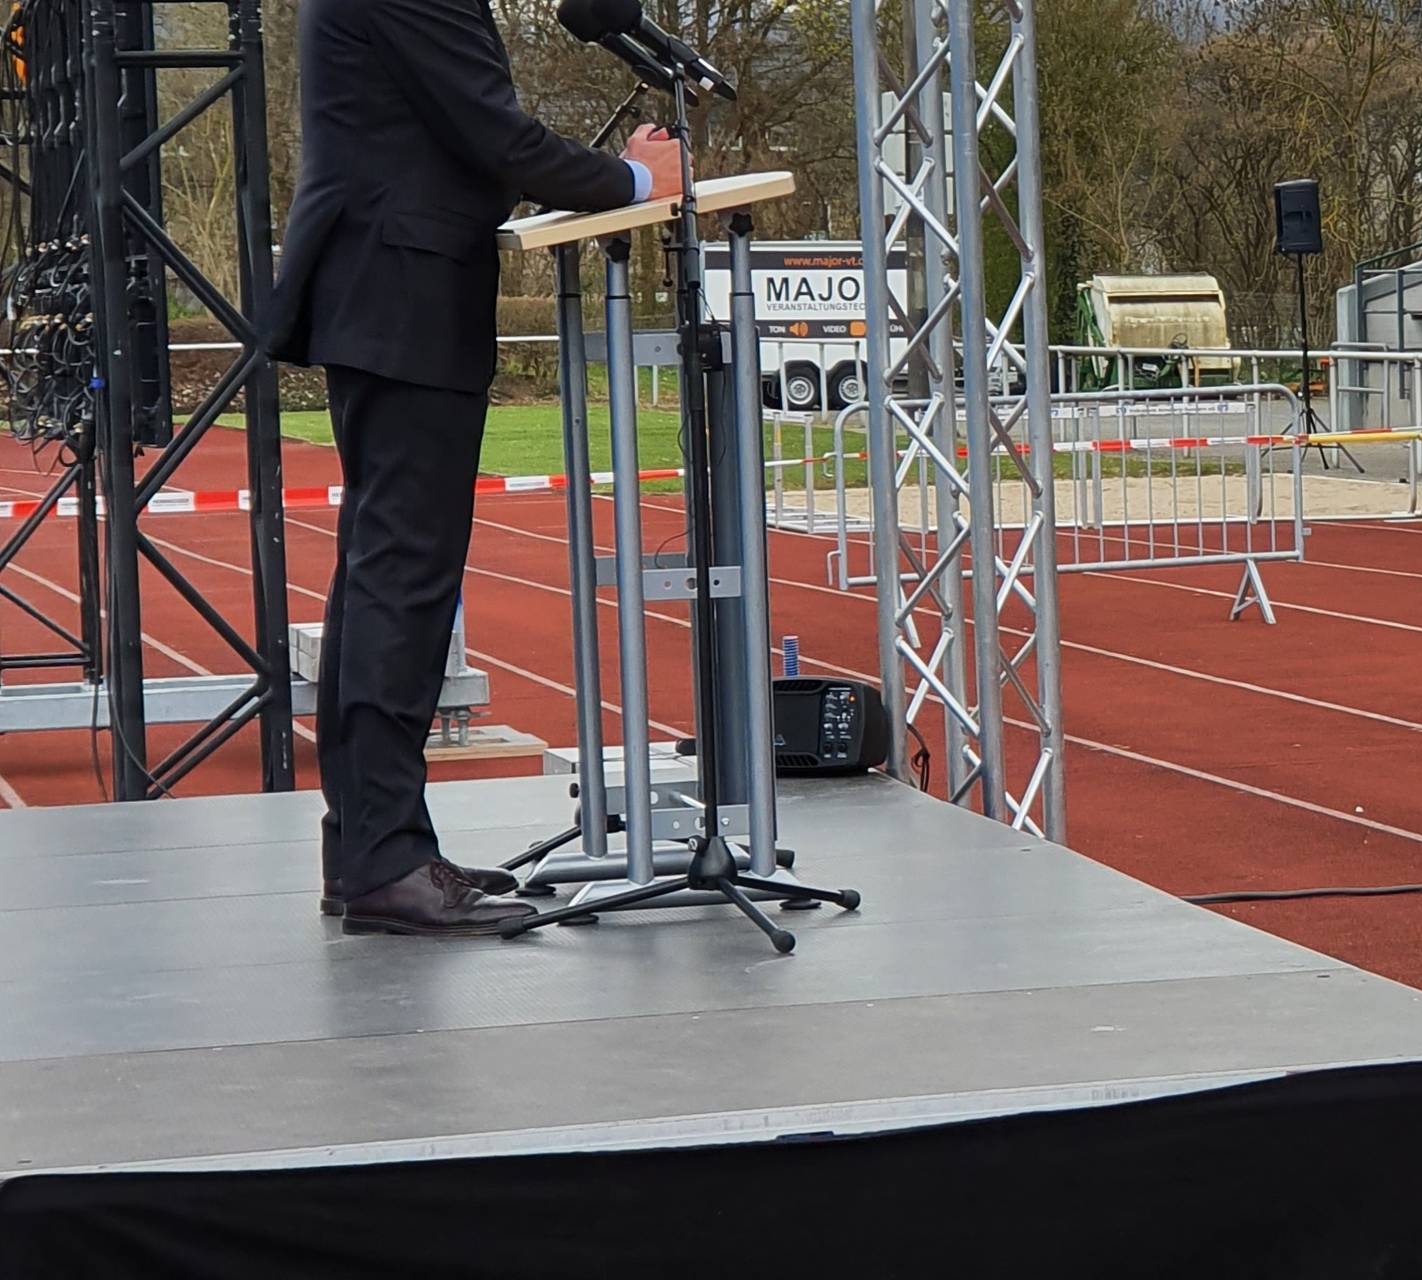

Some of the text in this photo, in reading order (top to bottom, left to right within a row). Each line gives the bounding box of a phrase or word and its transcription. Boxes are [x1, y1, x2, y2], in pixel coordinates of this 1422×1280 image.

[783, 256, 864, 268] www.major-vt.c
[766, 276, 861, 302] MAJO
[766, 303, 867, 312] VERANSTALTUNGSTEC
[768, 325, 847, 334] TON VIDEO
